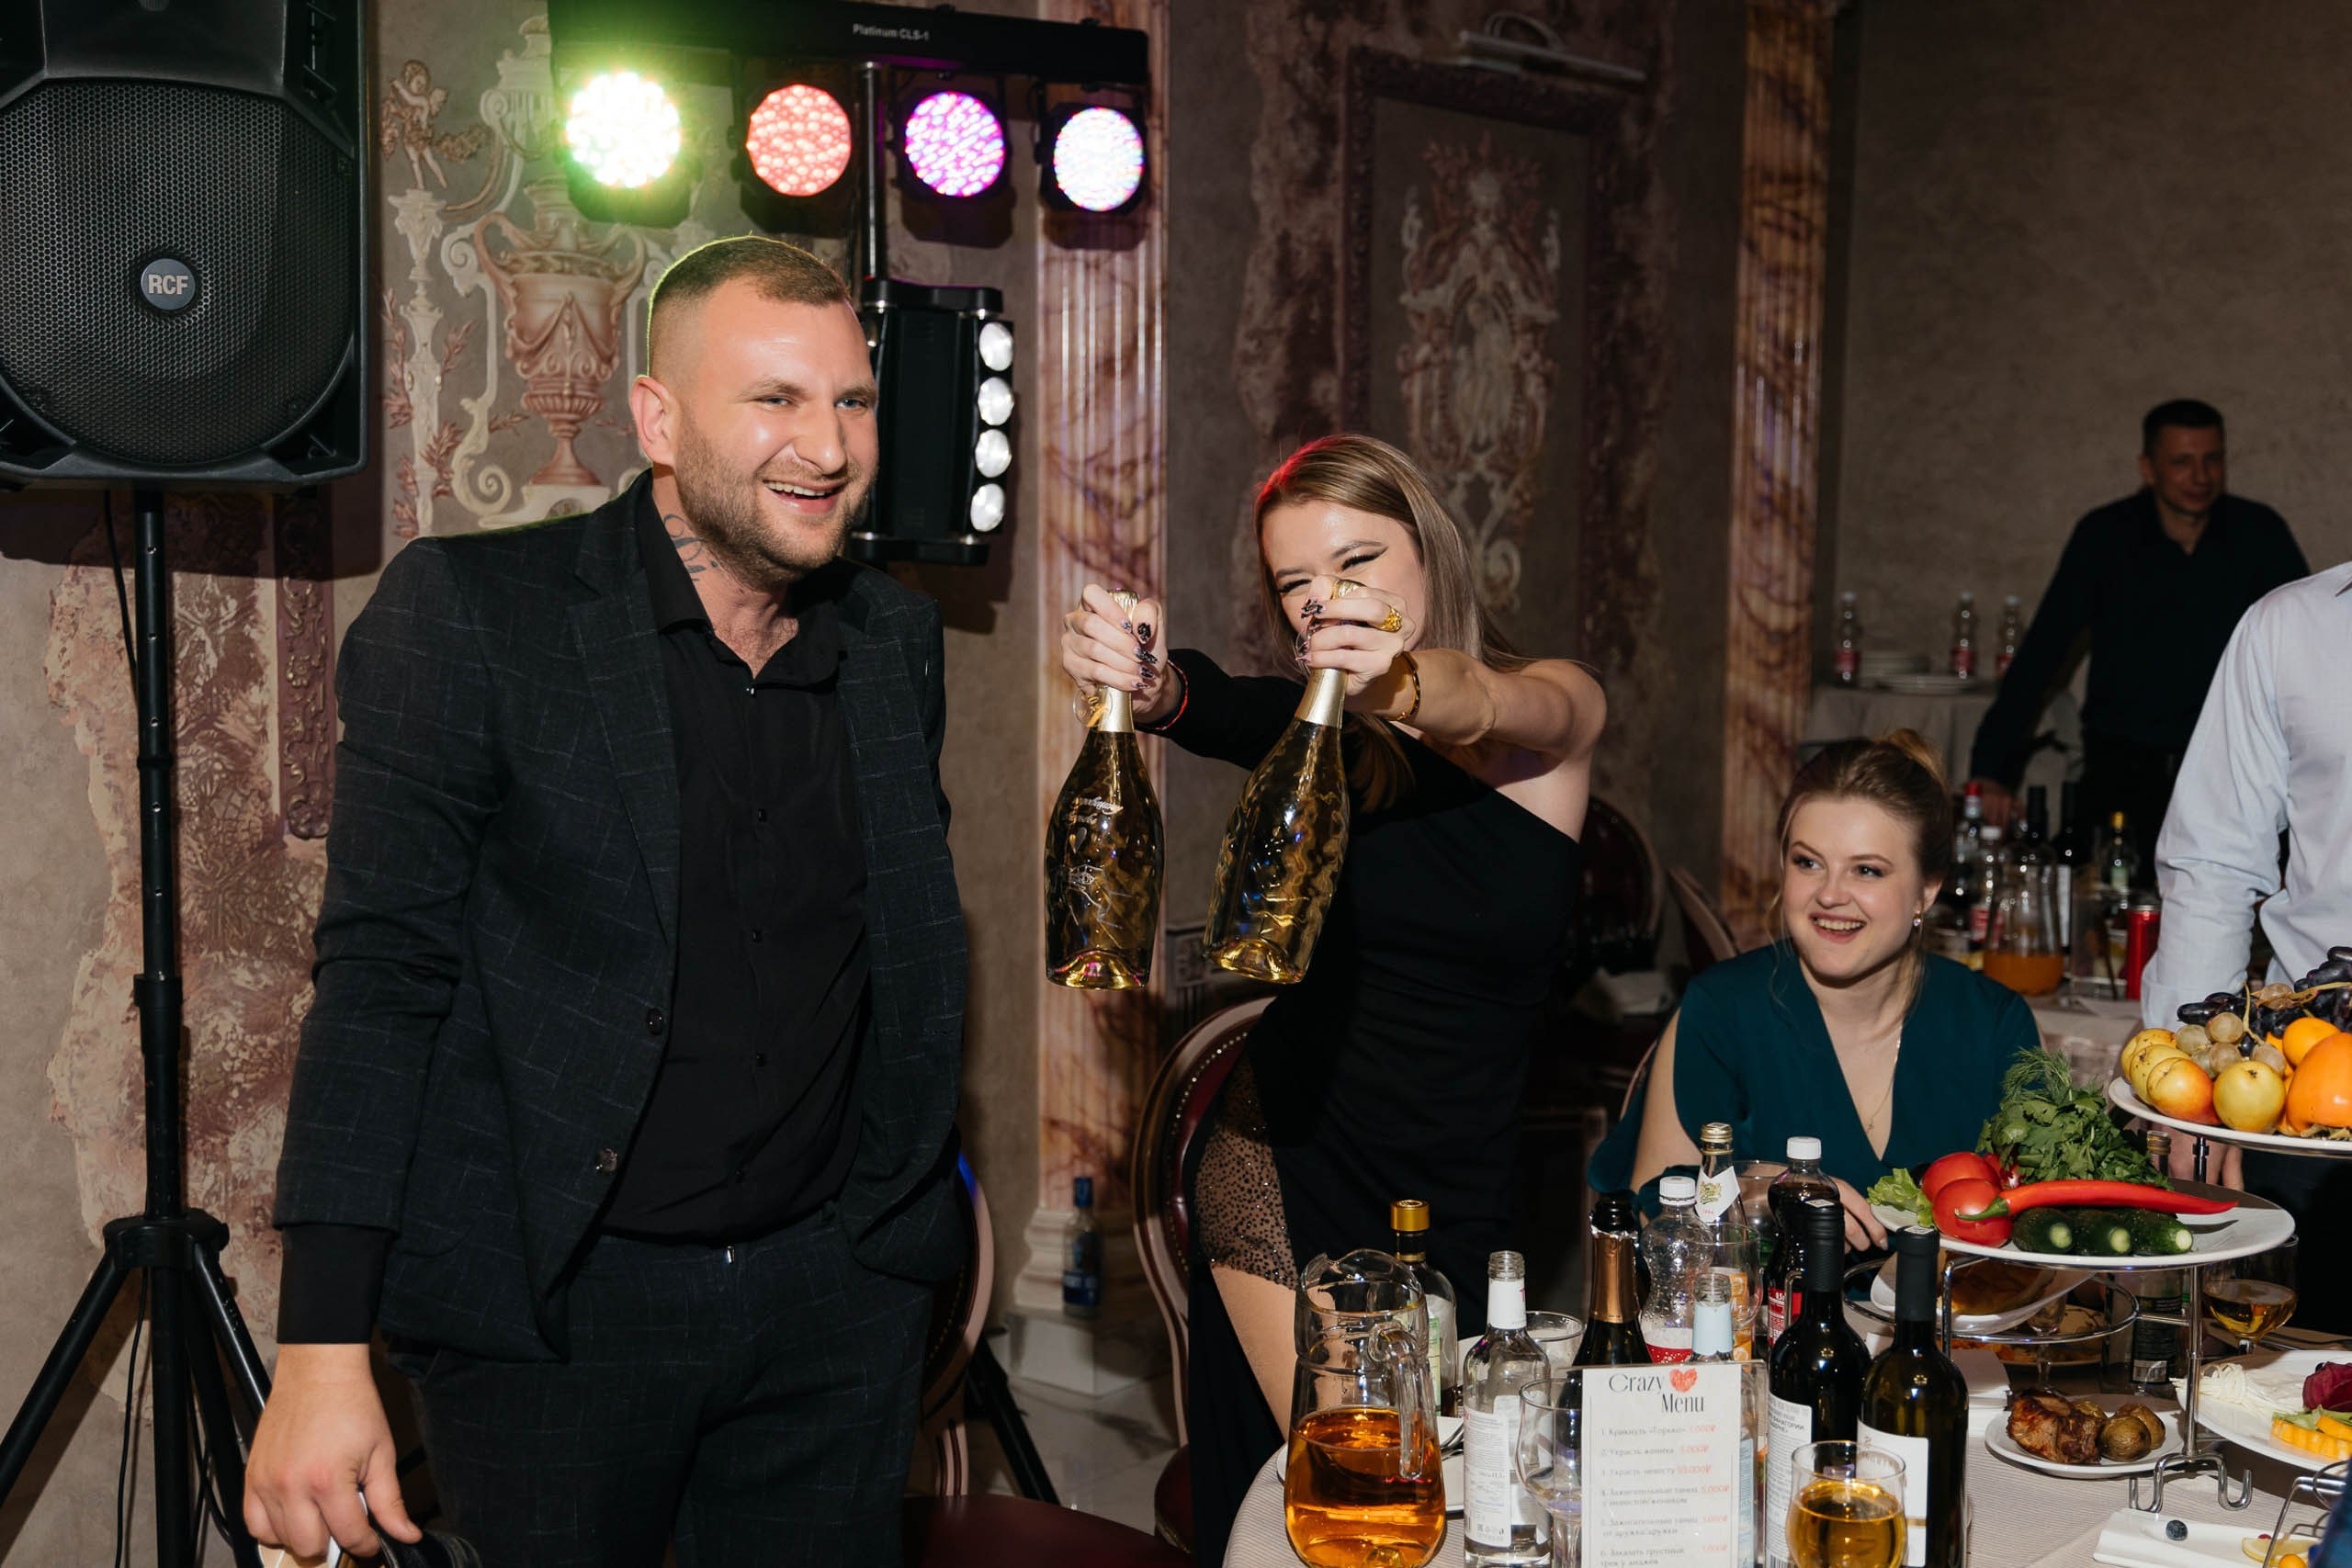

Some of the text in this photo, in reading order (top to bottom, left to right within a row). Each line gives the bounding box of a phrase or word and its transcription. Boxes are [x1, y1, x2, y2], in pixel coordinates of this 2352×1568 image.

[853, 23, 930, 41] Platinum CLS-1
[148, 274, 188, 295] RCF
[1609, 1373, 1664, 1394] Crazy
[1662, 1393, 1704, 1413] Menu
